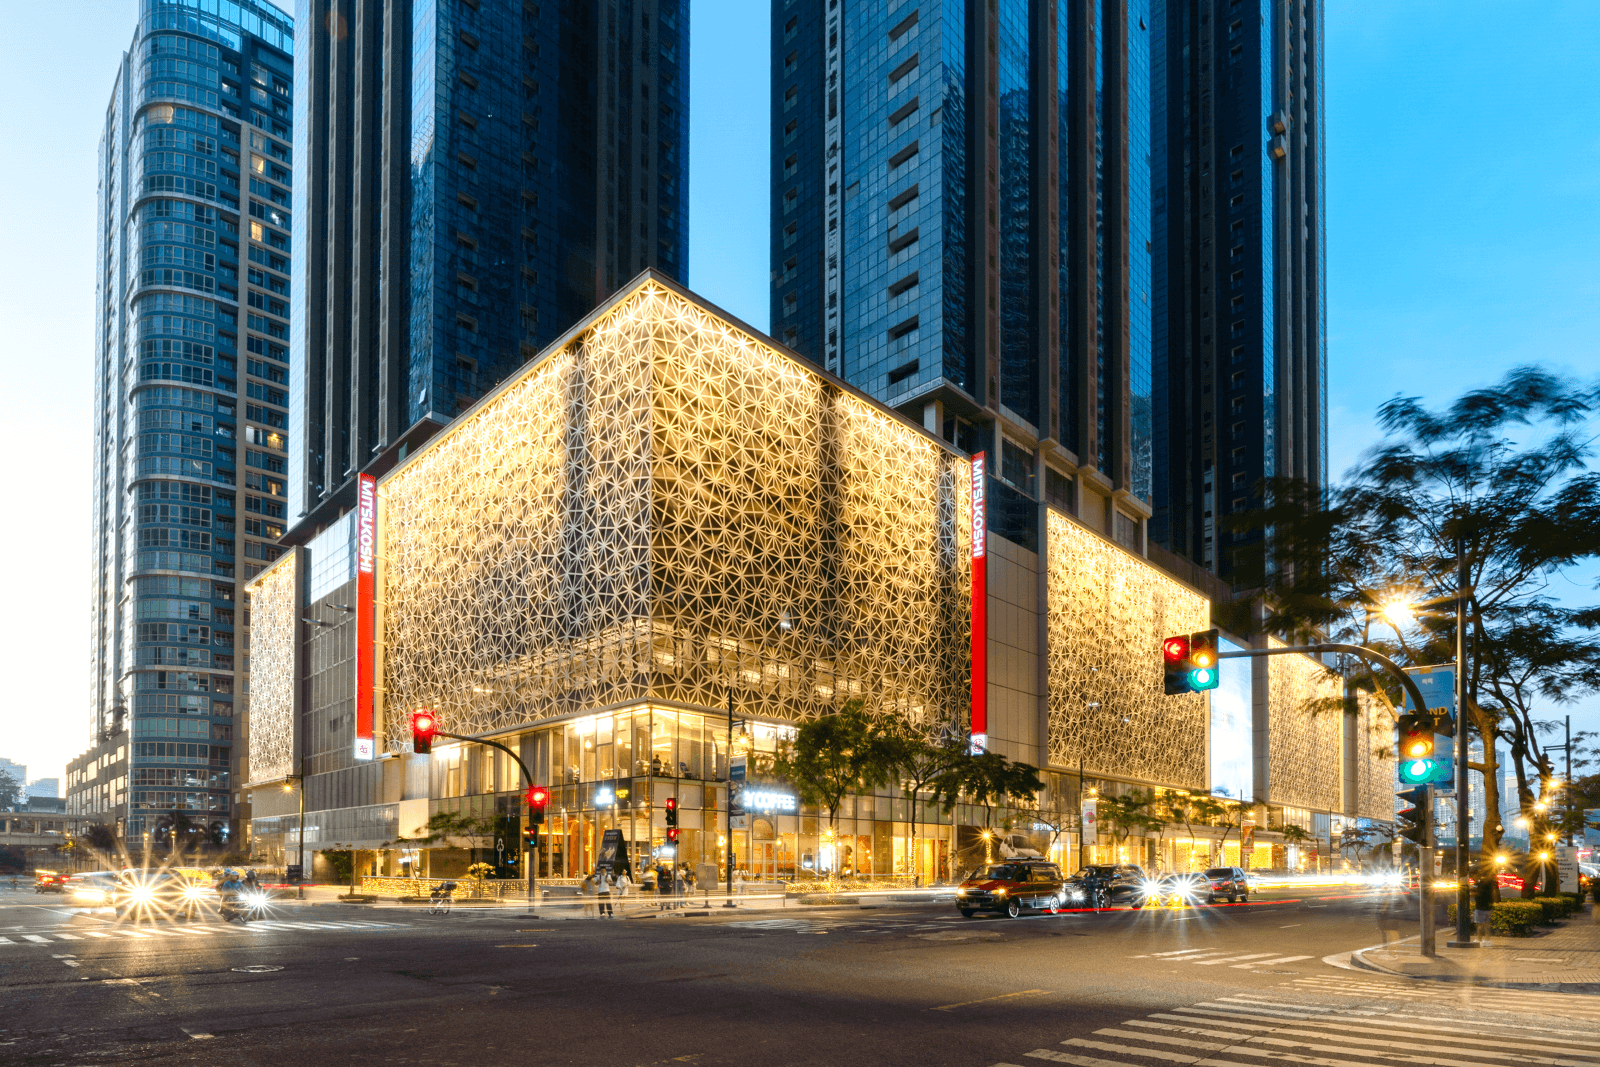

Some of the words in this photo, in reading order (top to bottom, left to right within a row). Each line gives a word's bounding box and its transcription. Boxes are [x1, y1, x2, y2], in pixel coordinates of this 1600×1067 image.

[360, 480, 373, 573] MITSUKOSHI
[973, 459, 983, 557] MITSUKOSHI
[1408, 706, 1448, 715] SND
[754, 791, 795, 809] COFFEE
